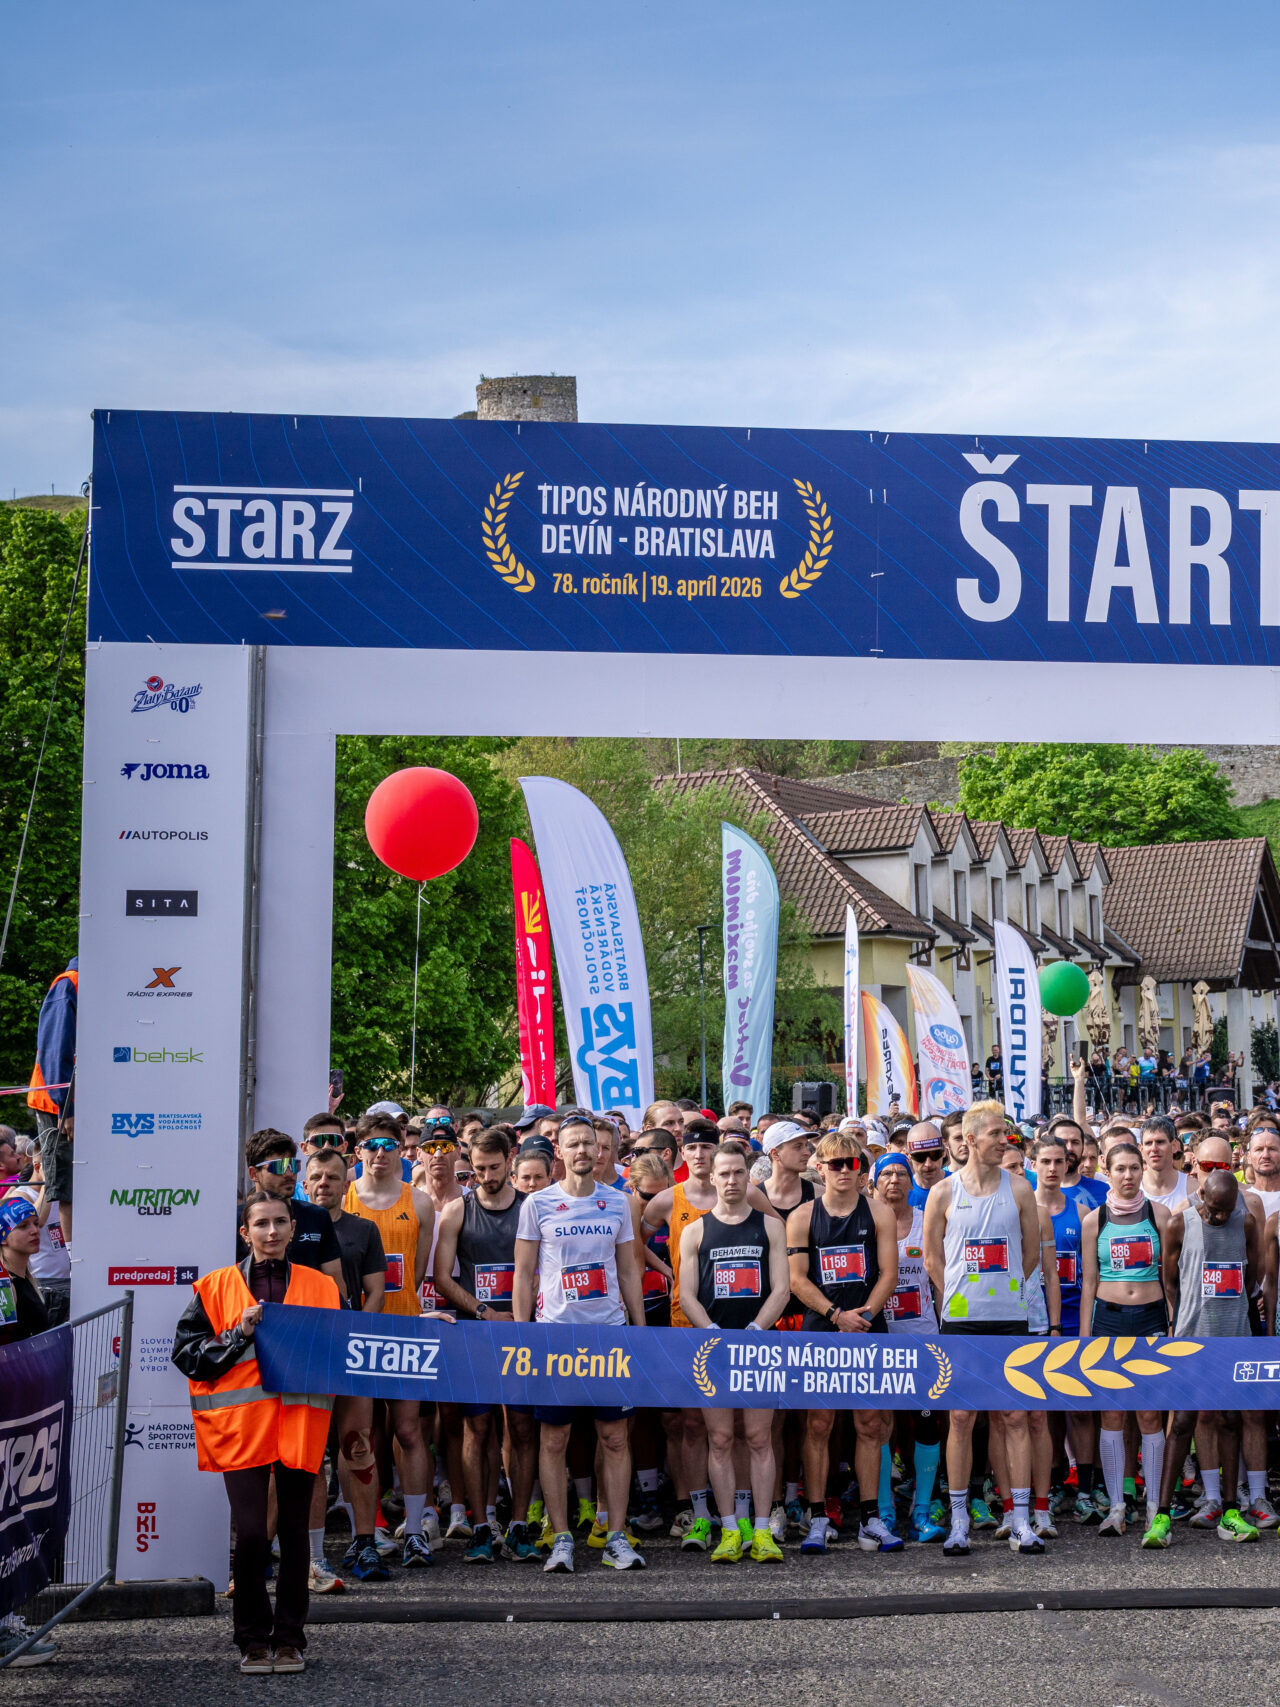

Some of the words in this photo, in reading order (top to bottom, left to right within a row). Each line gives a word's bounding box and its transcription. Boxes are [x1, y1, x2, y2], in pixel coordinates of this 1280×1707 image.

[538, 483, 607, 516] TIPOS
[614, 482, 727, 518] NÁRODNÝ
[734, 491, 777, 519] BEH
[542, 519, 611, 554] DEVÍN
[635, 527, 775, 558] BRATISLAVA
[553, 573, 577, 593] 78.
[583, 573, 638, 594] ročník
[651, 576, 672, 595] 19.
[682, 575, 716, 600] apríl
[721, 577, 761, 597] 2026
[134, 1047, 204, 1063] behsk
[112, 1113, 155, 1130] BVS
[110, 1189, 200, 1207] NUTRITION
[138, 1206, 172, 1216] CLUB
[555, 1225, 613, 1237] SLOVAKIA
[965, 1247, 985, 1260] 634
[1111, 1244, 1130, 1258] 386
[823, 1256, 847, 1269] 1158
[477, 1273, 497, 1287] 575
[564, 1272, 590, 1289] 1133
[716, 1270, 736, 1284] 888
[1203, 1270, 1222, 1284] 348
[502, 1347, 537, 1376] 78.
[547, 1348, 631, 1377] ročník
[727, 1344, 782, 1367] TIPOS
[788, 1343, 877, 1368] NÁRODNÝ
[883, 1348, 917, 1368] BEH
[730, 1370, 785, 1392] DEVÍN
[804, 1371, 916, 1394] BRATISLAVA
[148, 1442, 196, 1450] CENTRUM
[0, 1421, 60, 1511] IPOS
